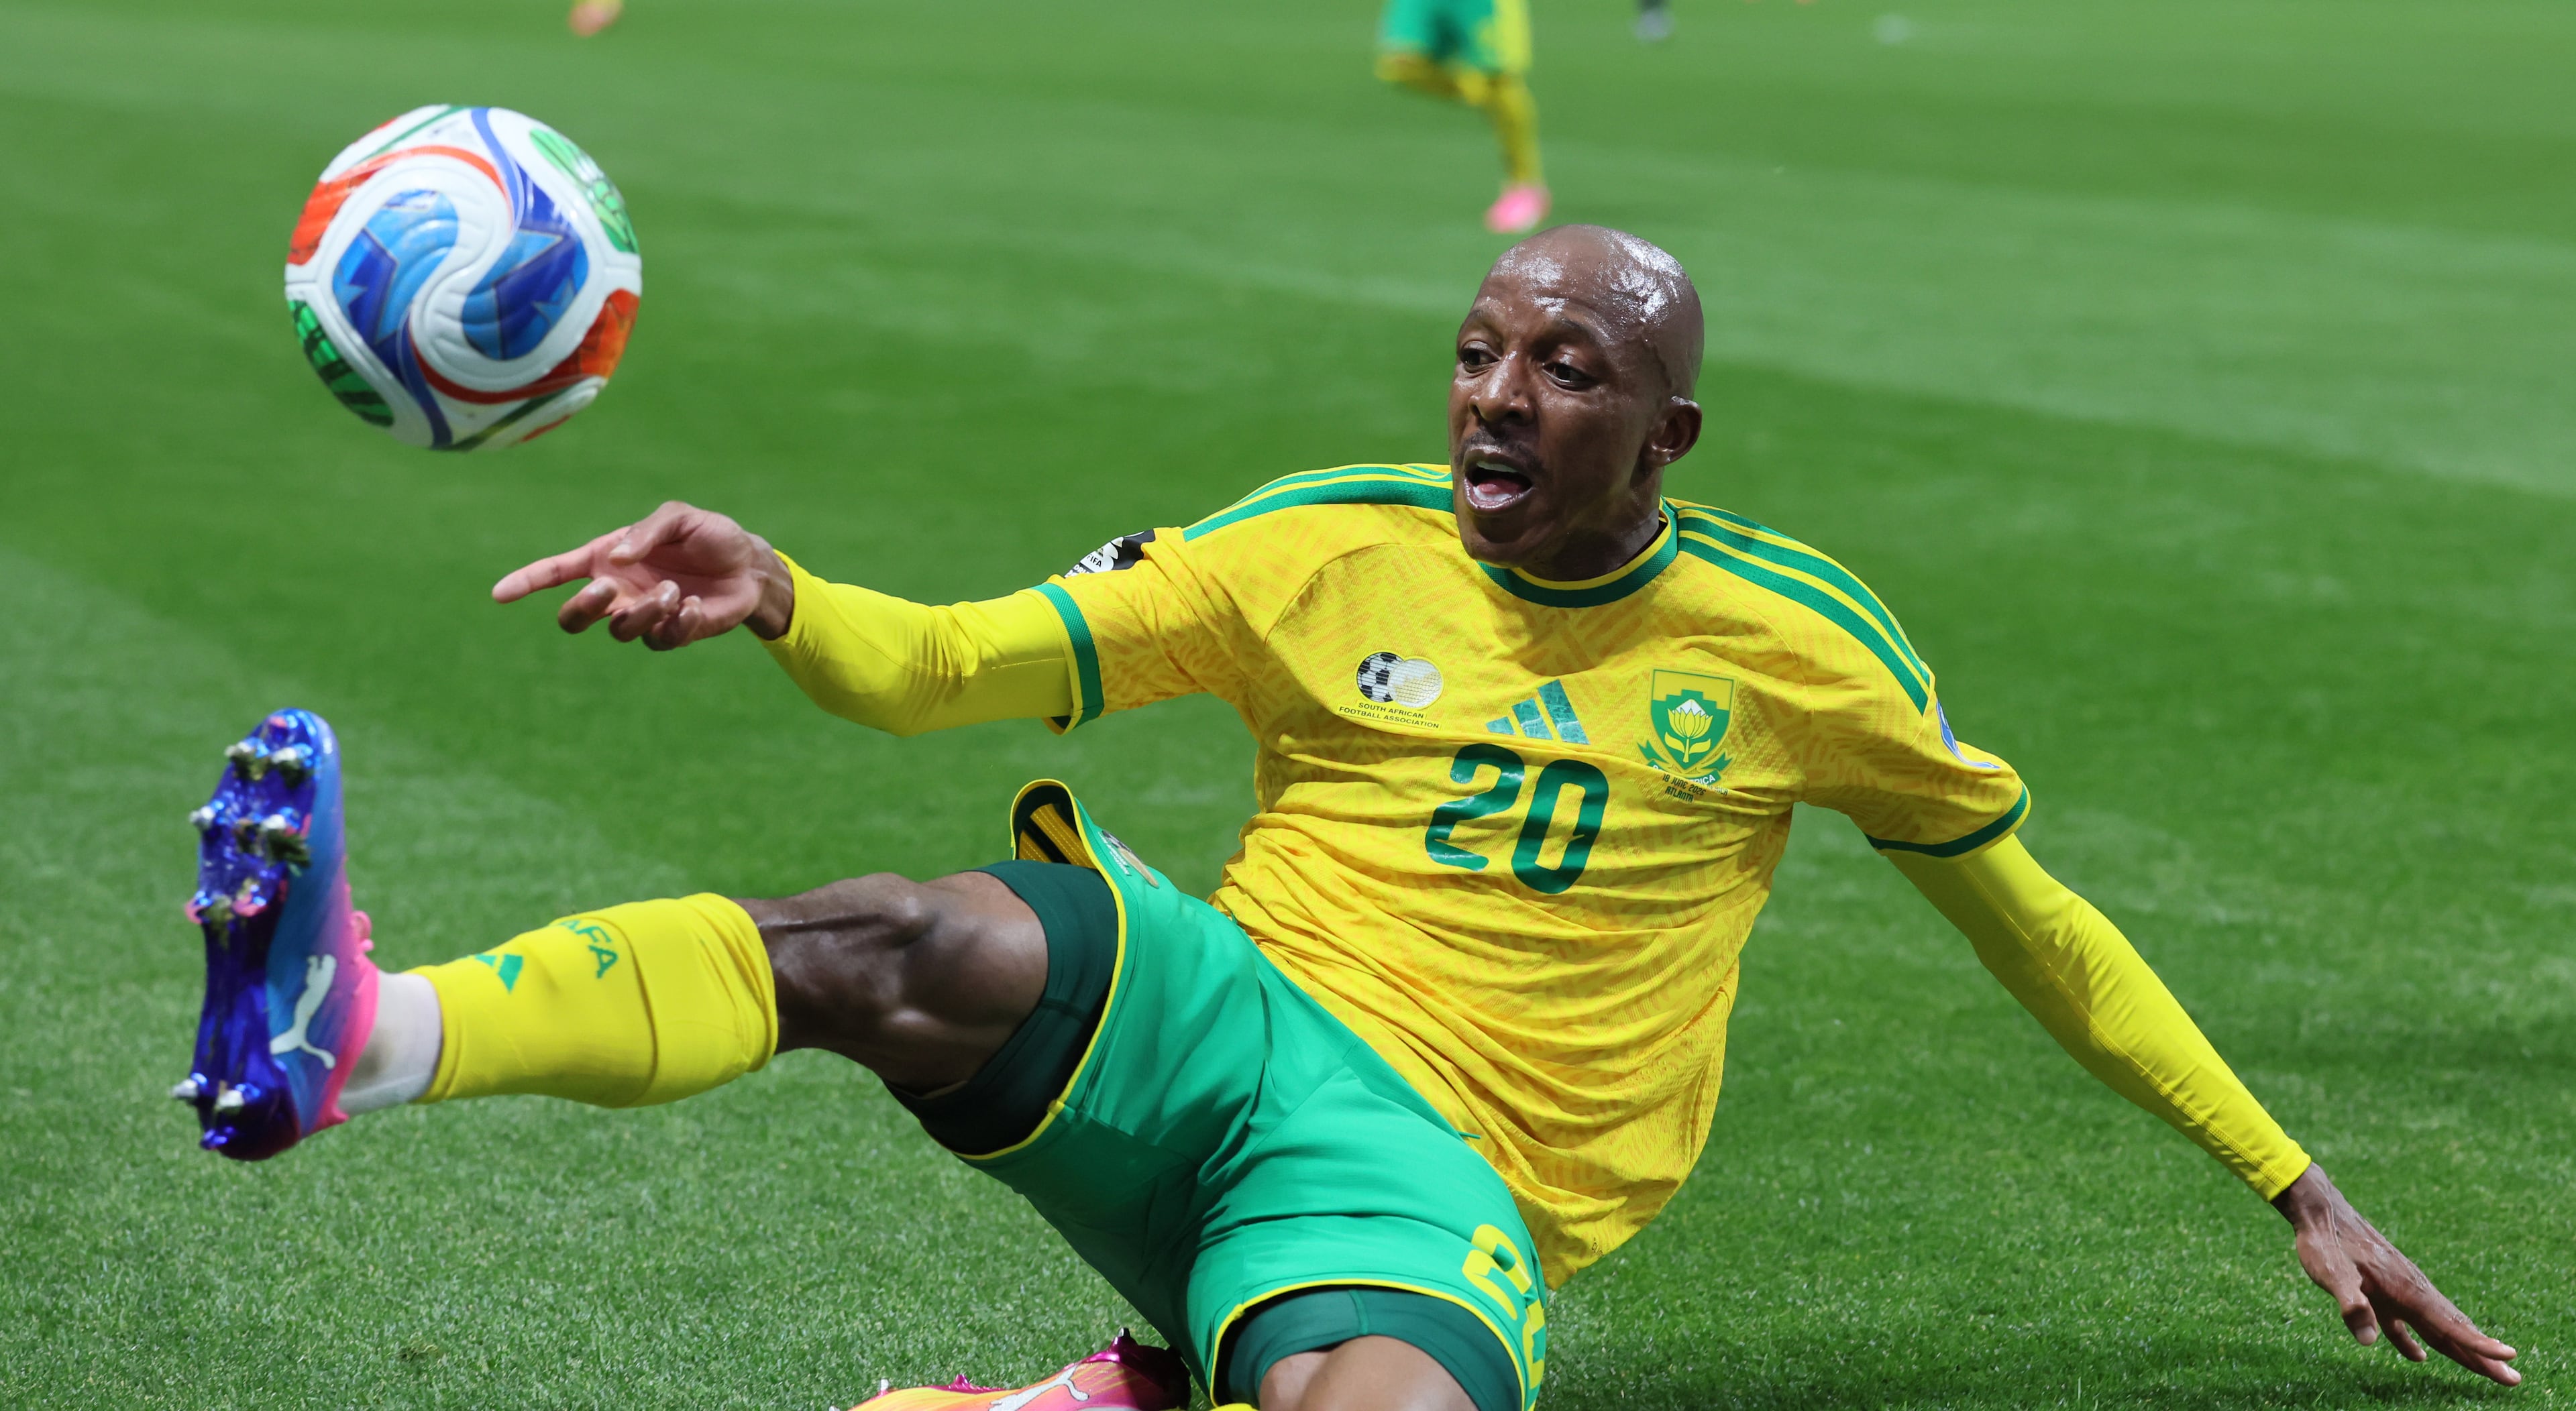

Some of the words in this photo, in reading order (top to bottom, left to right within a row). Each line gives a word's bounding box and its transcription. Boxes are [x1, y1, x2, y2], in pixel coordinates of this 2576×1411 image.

[1339, 706, 1381, 720] FOOTBALL
[1383, 715, 1440, 729] ASSOCIATION
[1358, 702, 1386, 712] SOUTH
[1388, 708, 1424, 719] AFRICAN
[1662, 773, 1670, 783] 18
[1671, 777, 1688, 790] JUNE
[1688, 783, 1707, 796] 2026
[1688, 774, 1716, 785] RICA
[1664, 786, 1694, 803] ATLANTA
[1425, 742, 1609, 895] 20
[558, 919, 619, 979] AFA
